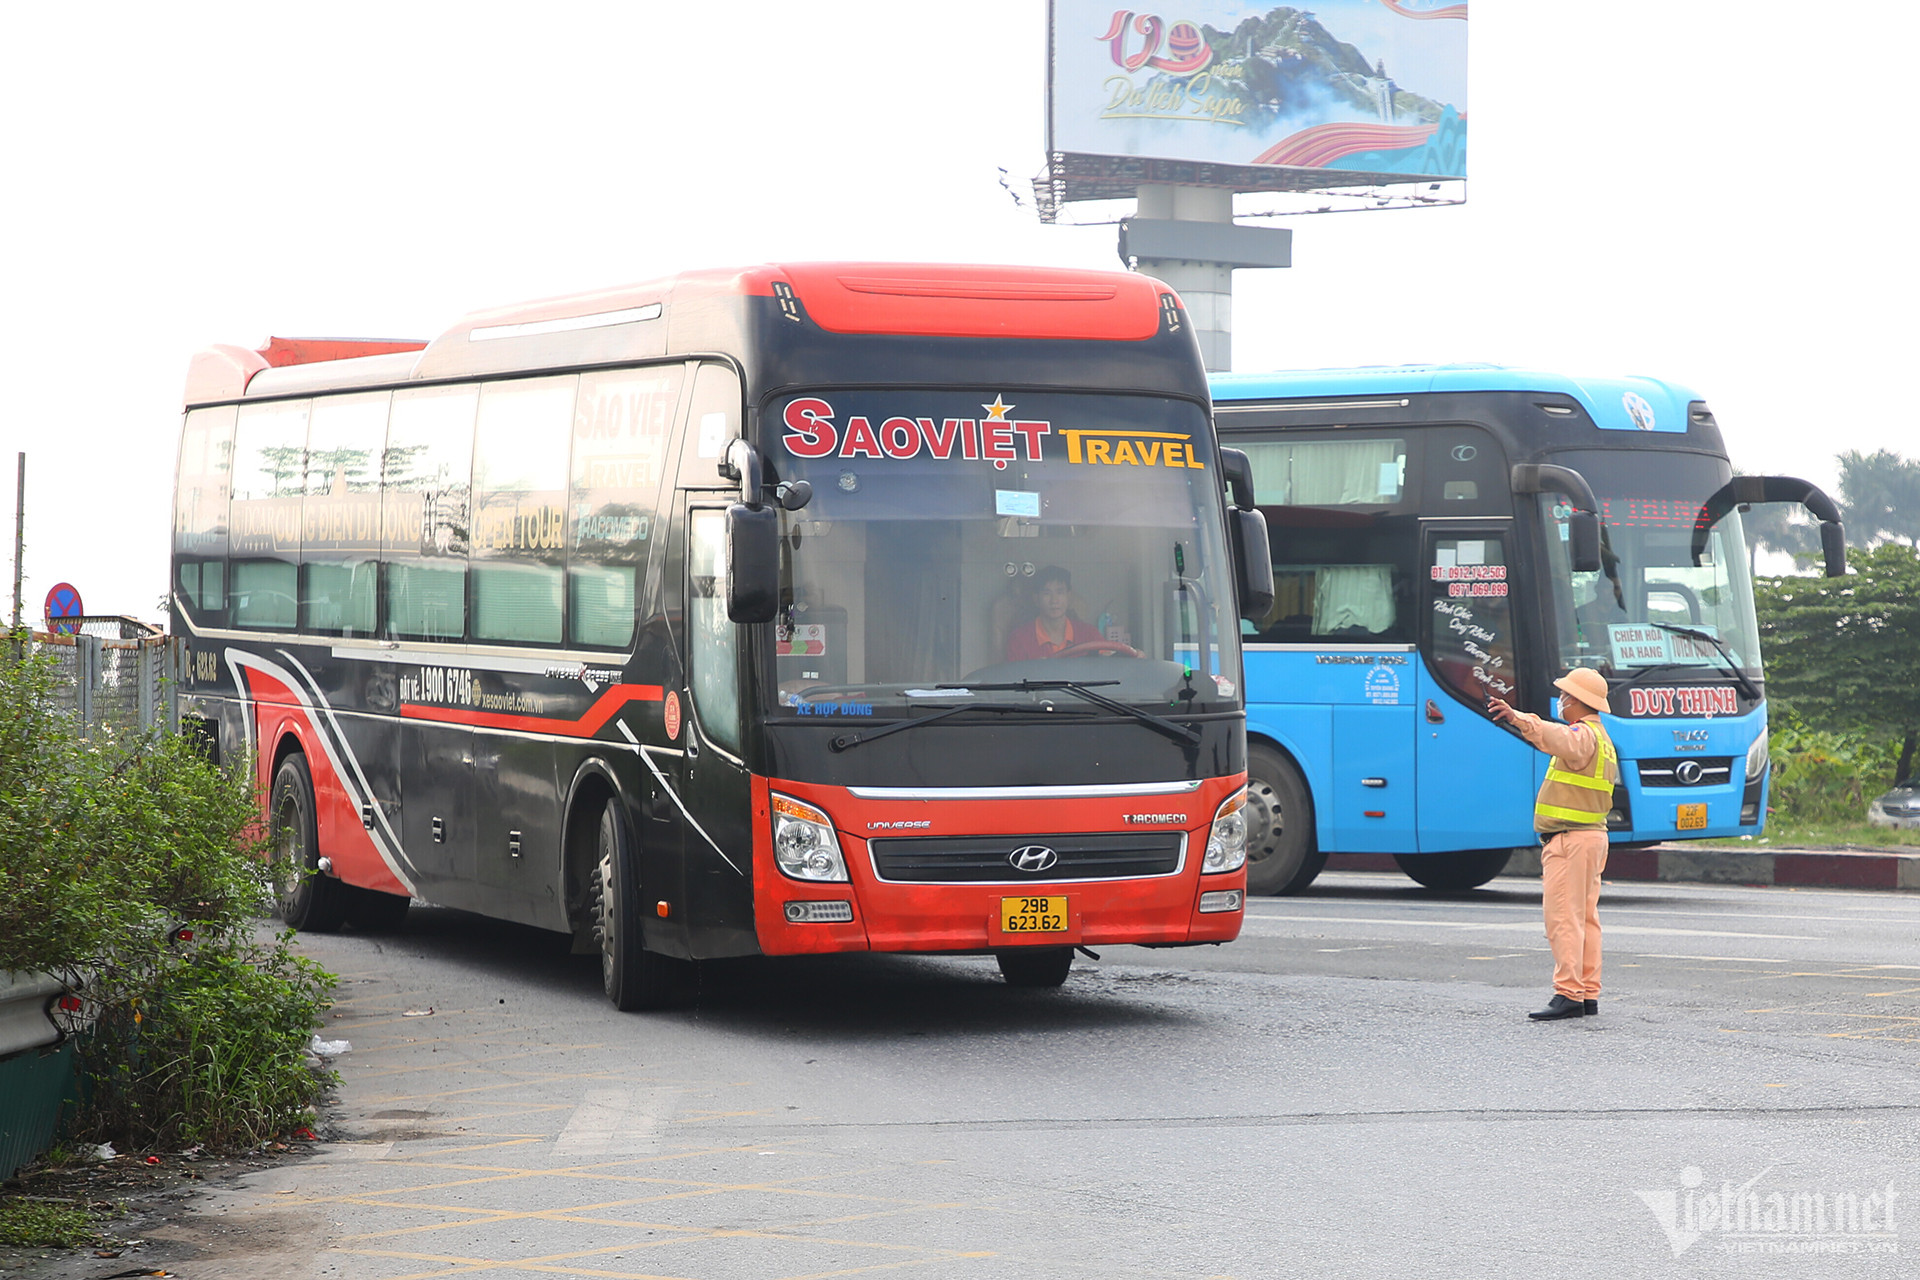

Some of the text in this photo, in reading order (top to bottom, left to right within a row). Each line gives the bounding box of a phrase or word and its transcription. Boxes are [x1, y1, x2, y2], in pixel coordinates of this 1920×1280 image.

[1104, 75, 1142, 110] Du
[1058, 428, 1204, 470] TRAVEL
[472, 506, 563, 550] OPEN TOUR
[1448, 565, 1507, 580] 0912.142.503
[1448, 583, 1508, 597] 0971.069.899
[1620, 646, 1663, 659] NA HANG
[421, 666, 445, 703] 1900
[447, 668, 472, 705] 6746
[482, 692, 544, 714] xesaoviet.com.vn
[797, 703, 812, 715] XE
[1629, 687, 1738, 719] DUY THỊNH
[1672, 730, 1709, 741] THACO
[867, 813, 1187, 830] UNIVERSE TRACOMECO
[1020, 897, 1049, 914] 29B
[1008, 914, 1061, 931] 623.62
